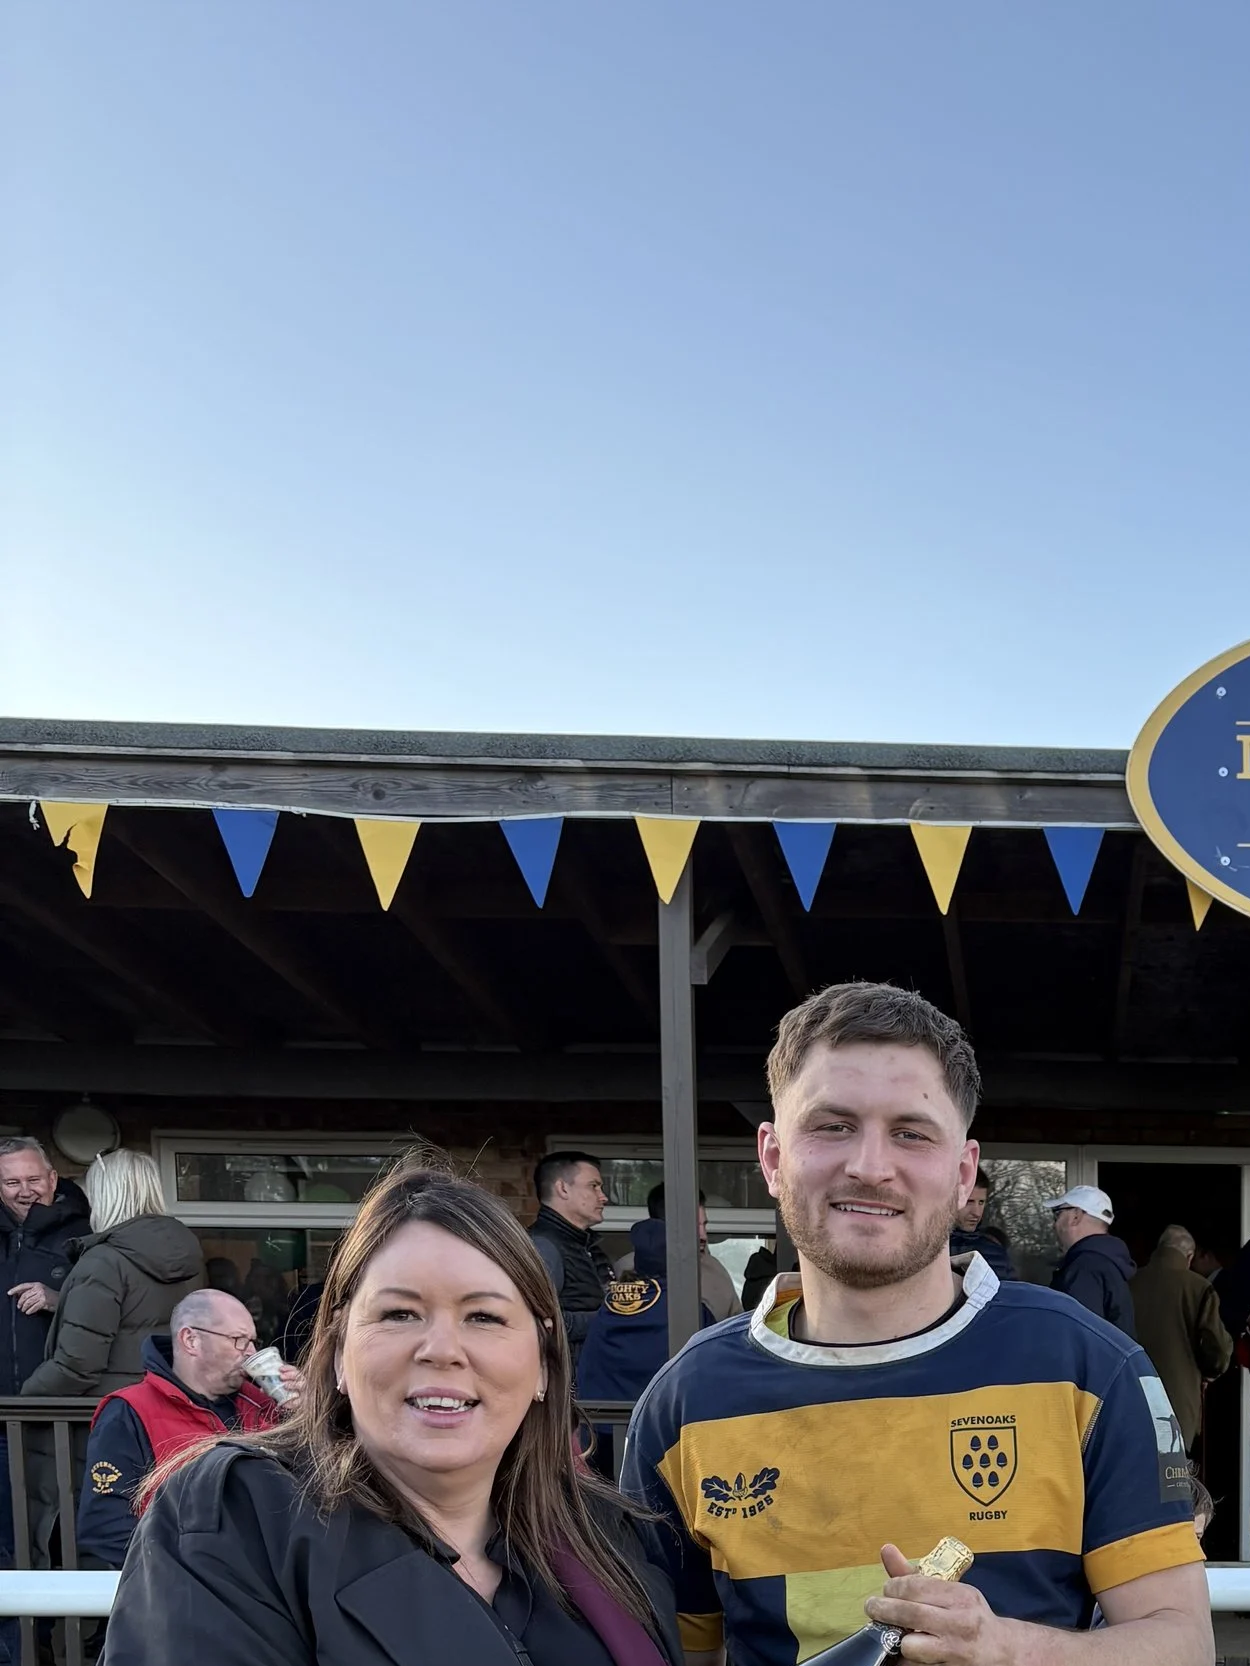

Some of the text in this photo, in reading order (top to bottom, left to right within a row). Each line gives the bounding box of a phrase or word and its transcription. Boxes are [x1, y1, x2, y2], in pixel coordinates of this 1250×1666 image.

[950, 1414, 1017, 1428] SEVENOAKS
[741, 1494, 775, 1519] 1925
[969, 1510, 1008, 1521] RUGBY
